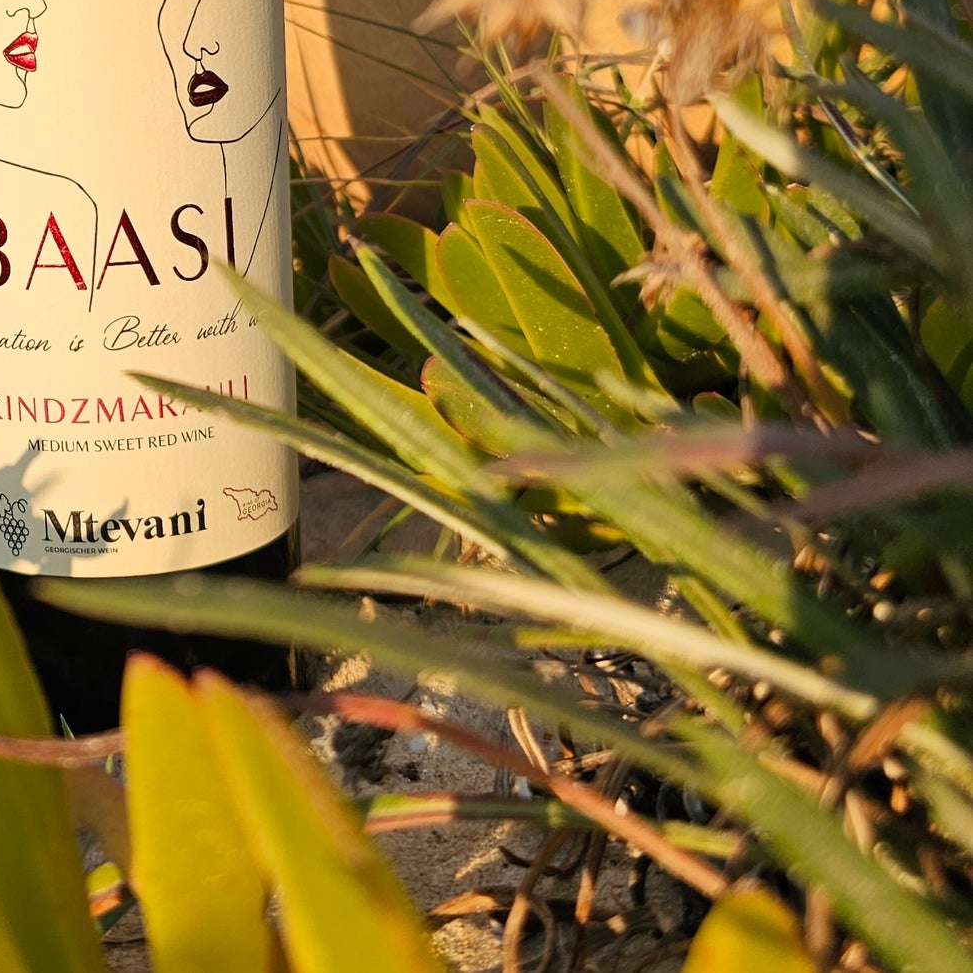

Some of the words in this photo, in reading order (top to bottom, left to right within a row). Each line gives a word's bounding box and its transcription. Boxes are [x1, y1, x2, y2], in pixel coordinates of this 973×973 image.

[68, 333, 85, 353] is
[102, 314, 182, 352] Better
[196, 298, 244, 340] with
[27, 438, 90, 453] MEDIUM
[93, 437, 144, 453] SWEET
[148, 432, 178, 449] RED
[180, 426, 216, 443] WINE
[242, 498, 272, 515] GEORGIA
[39, 497, 209, 544] Mtevani
[44, 545, 97, 555] GEORGISCHER
[97, 546, 120, 555] WEIN
